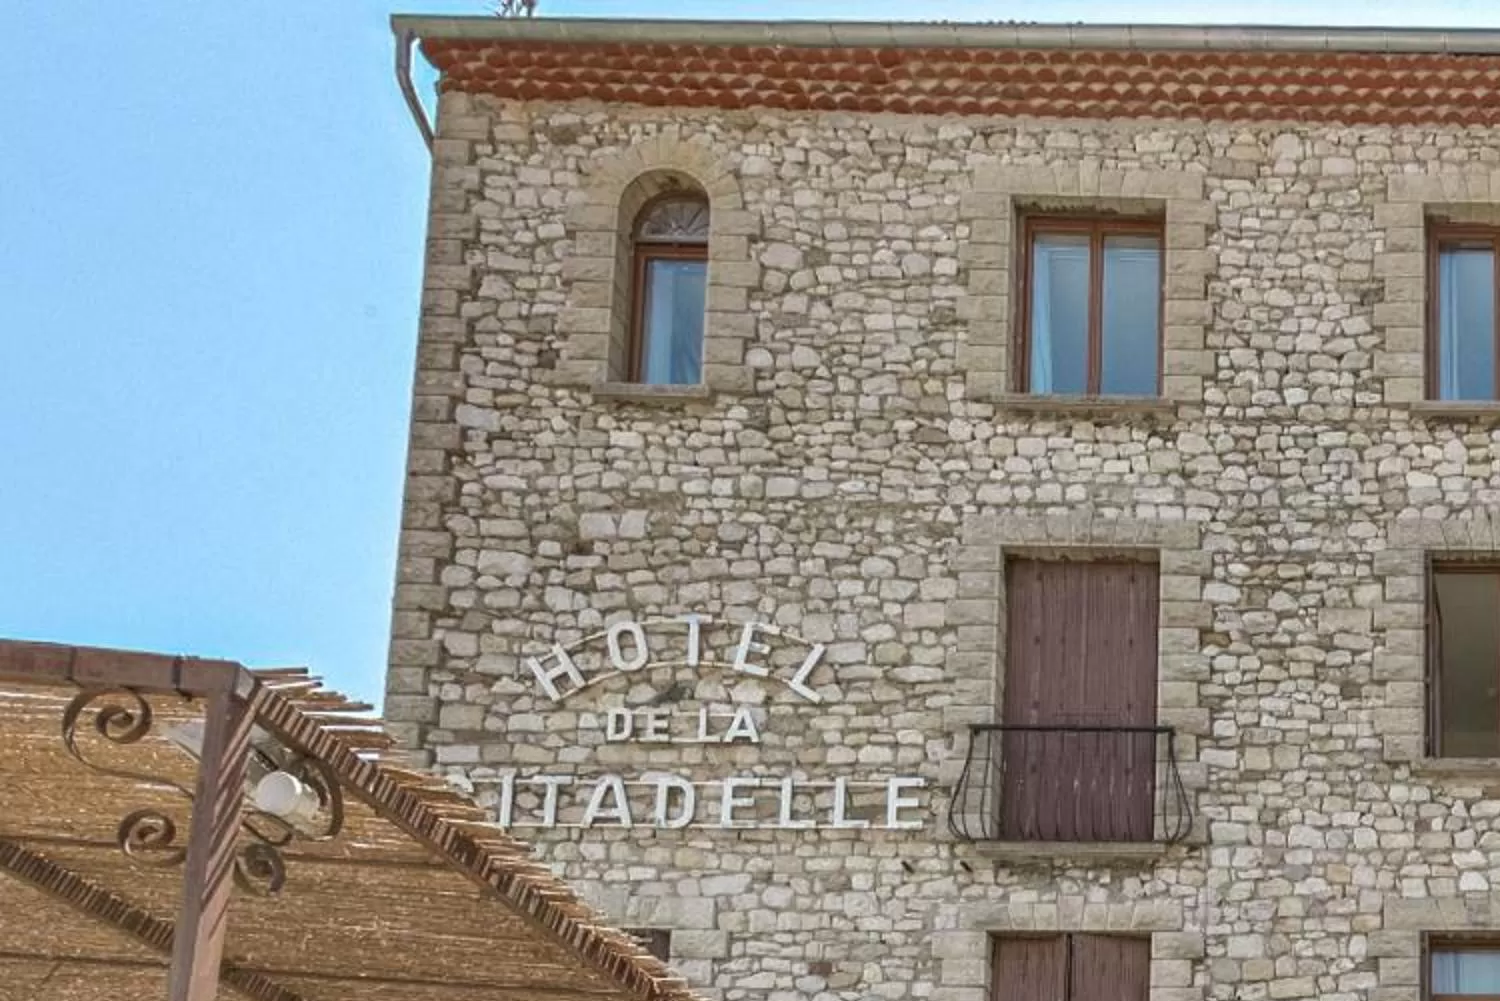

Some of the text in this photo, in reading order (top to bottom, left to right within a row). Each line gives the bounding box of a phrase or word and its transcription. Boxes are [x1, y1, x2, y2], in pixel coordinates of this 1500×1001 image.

[526, 613, 826, 703] HOTEL
[605, 708, 760, 743] DE LA
[446, 774, 926, 829] ITADELLE
